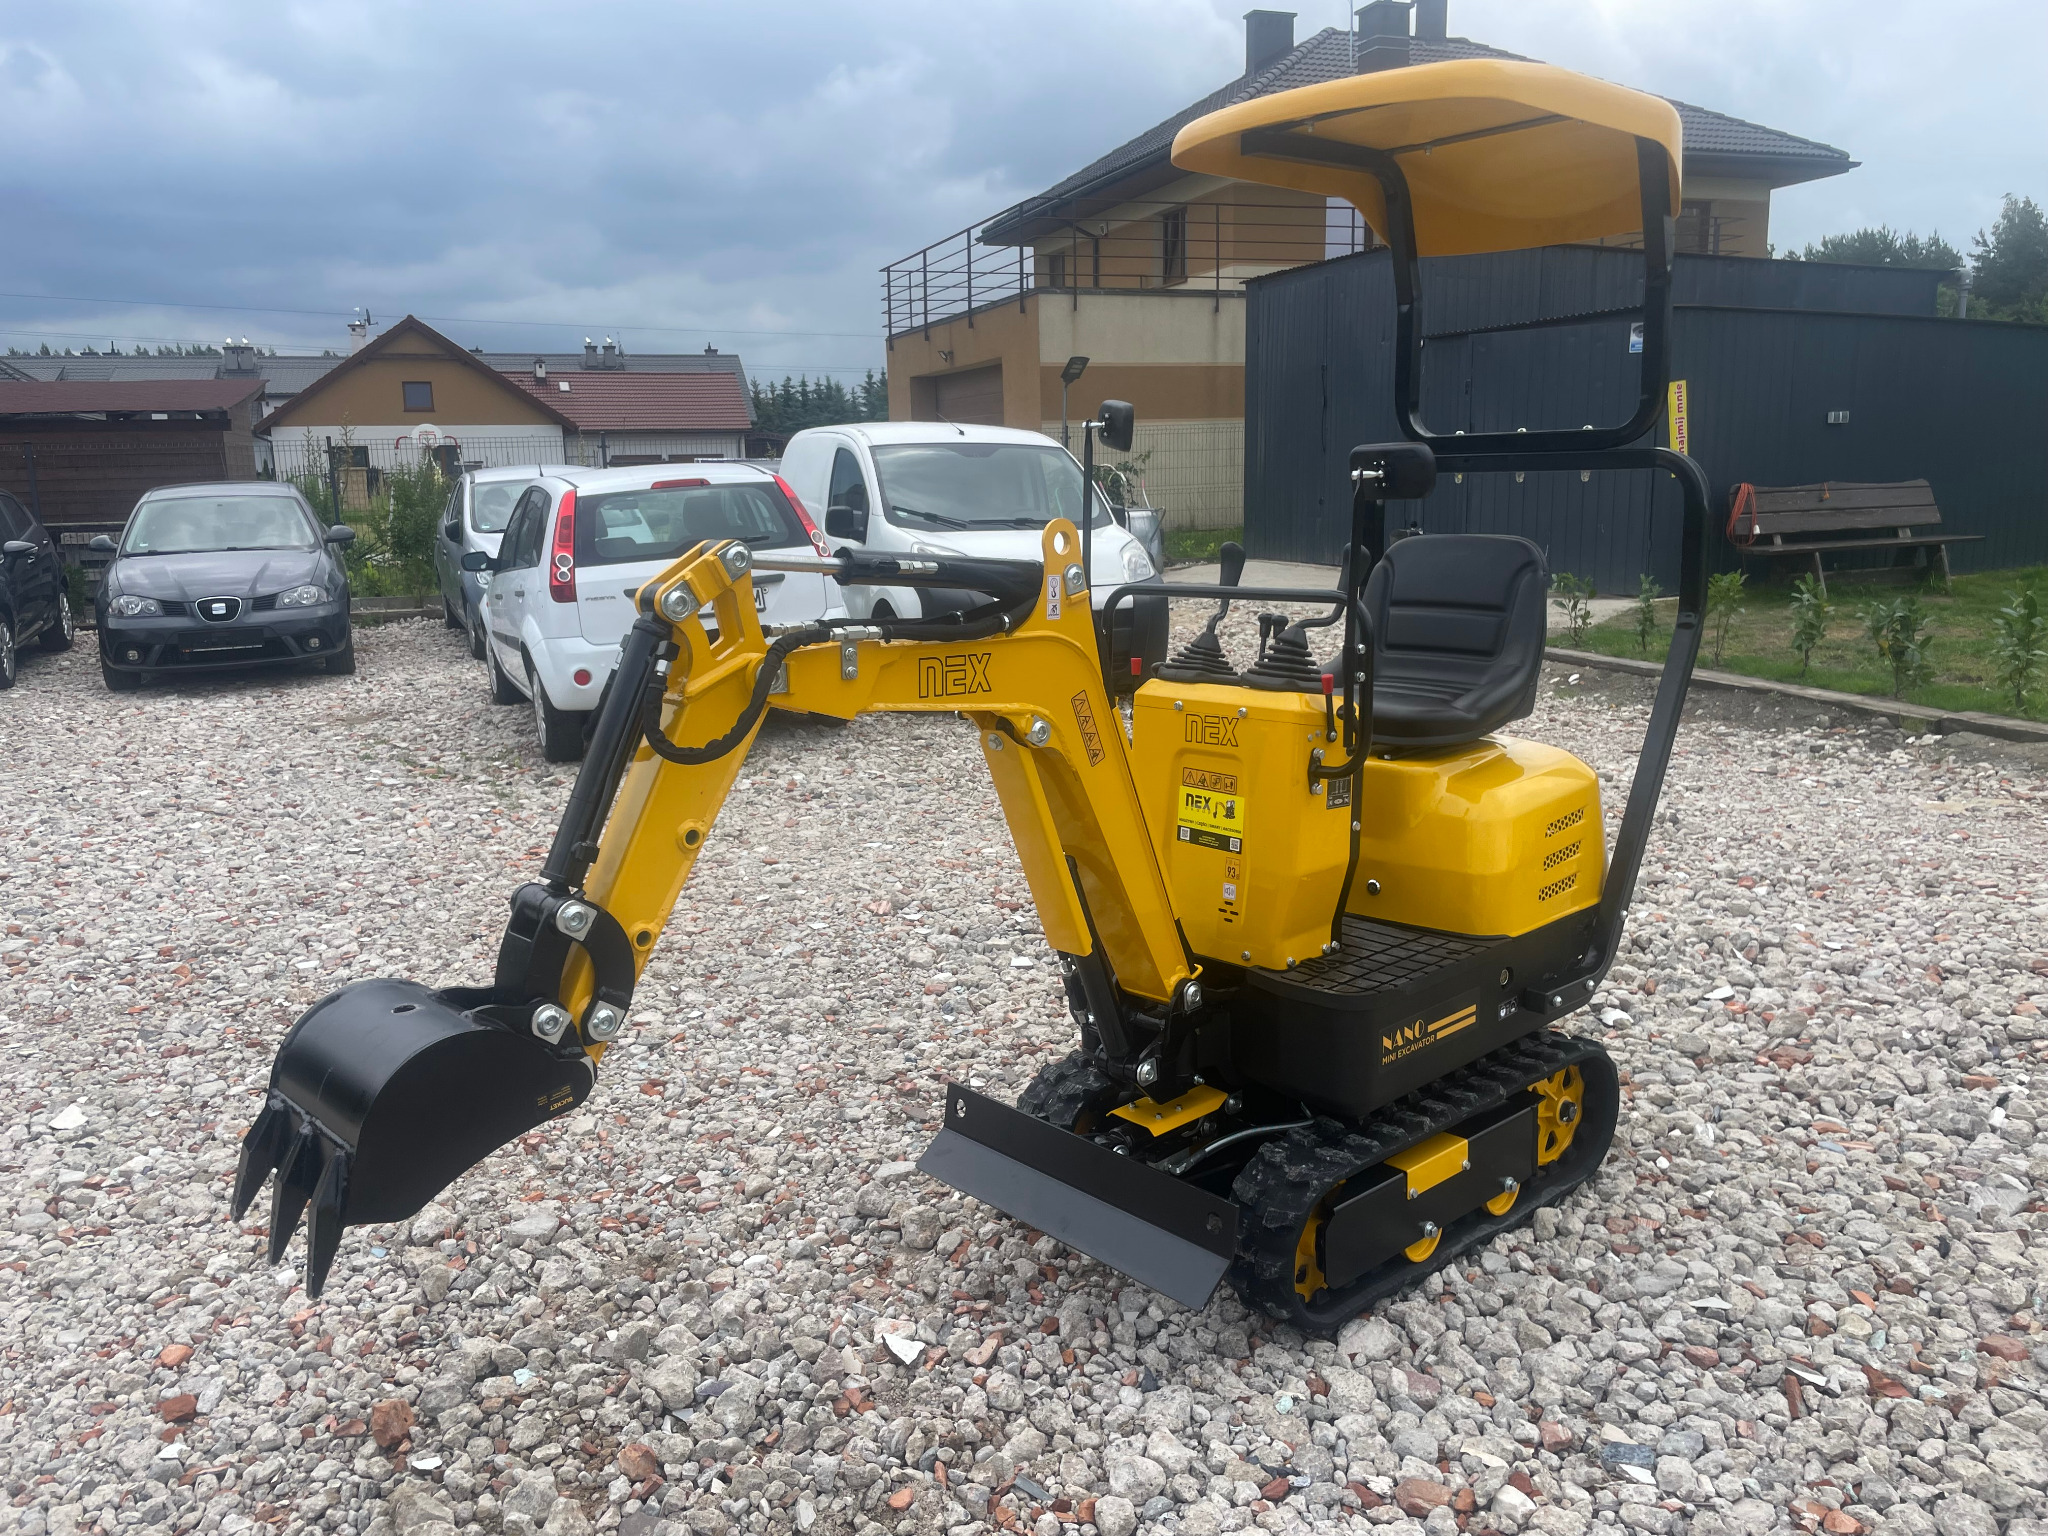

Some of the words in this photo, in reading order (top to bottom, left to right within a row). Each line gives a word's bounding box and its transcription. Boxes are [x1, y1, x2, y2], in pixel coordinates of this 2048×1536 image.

[1674, 383, 1684, 414] mnie
[1227, 866, 1236, 879] 93
[1382, 1019, 1425, 1055] NANO
[1382, 1052, 1397, 1066] MINI
[1397, 1034, 1435, 1059] EXCAVATOR
[550, 1096, 574, 1111] BUCKET
